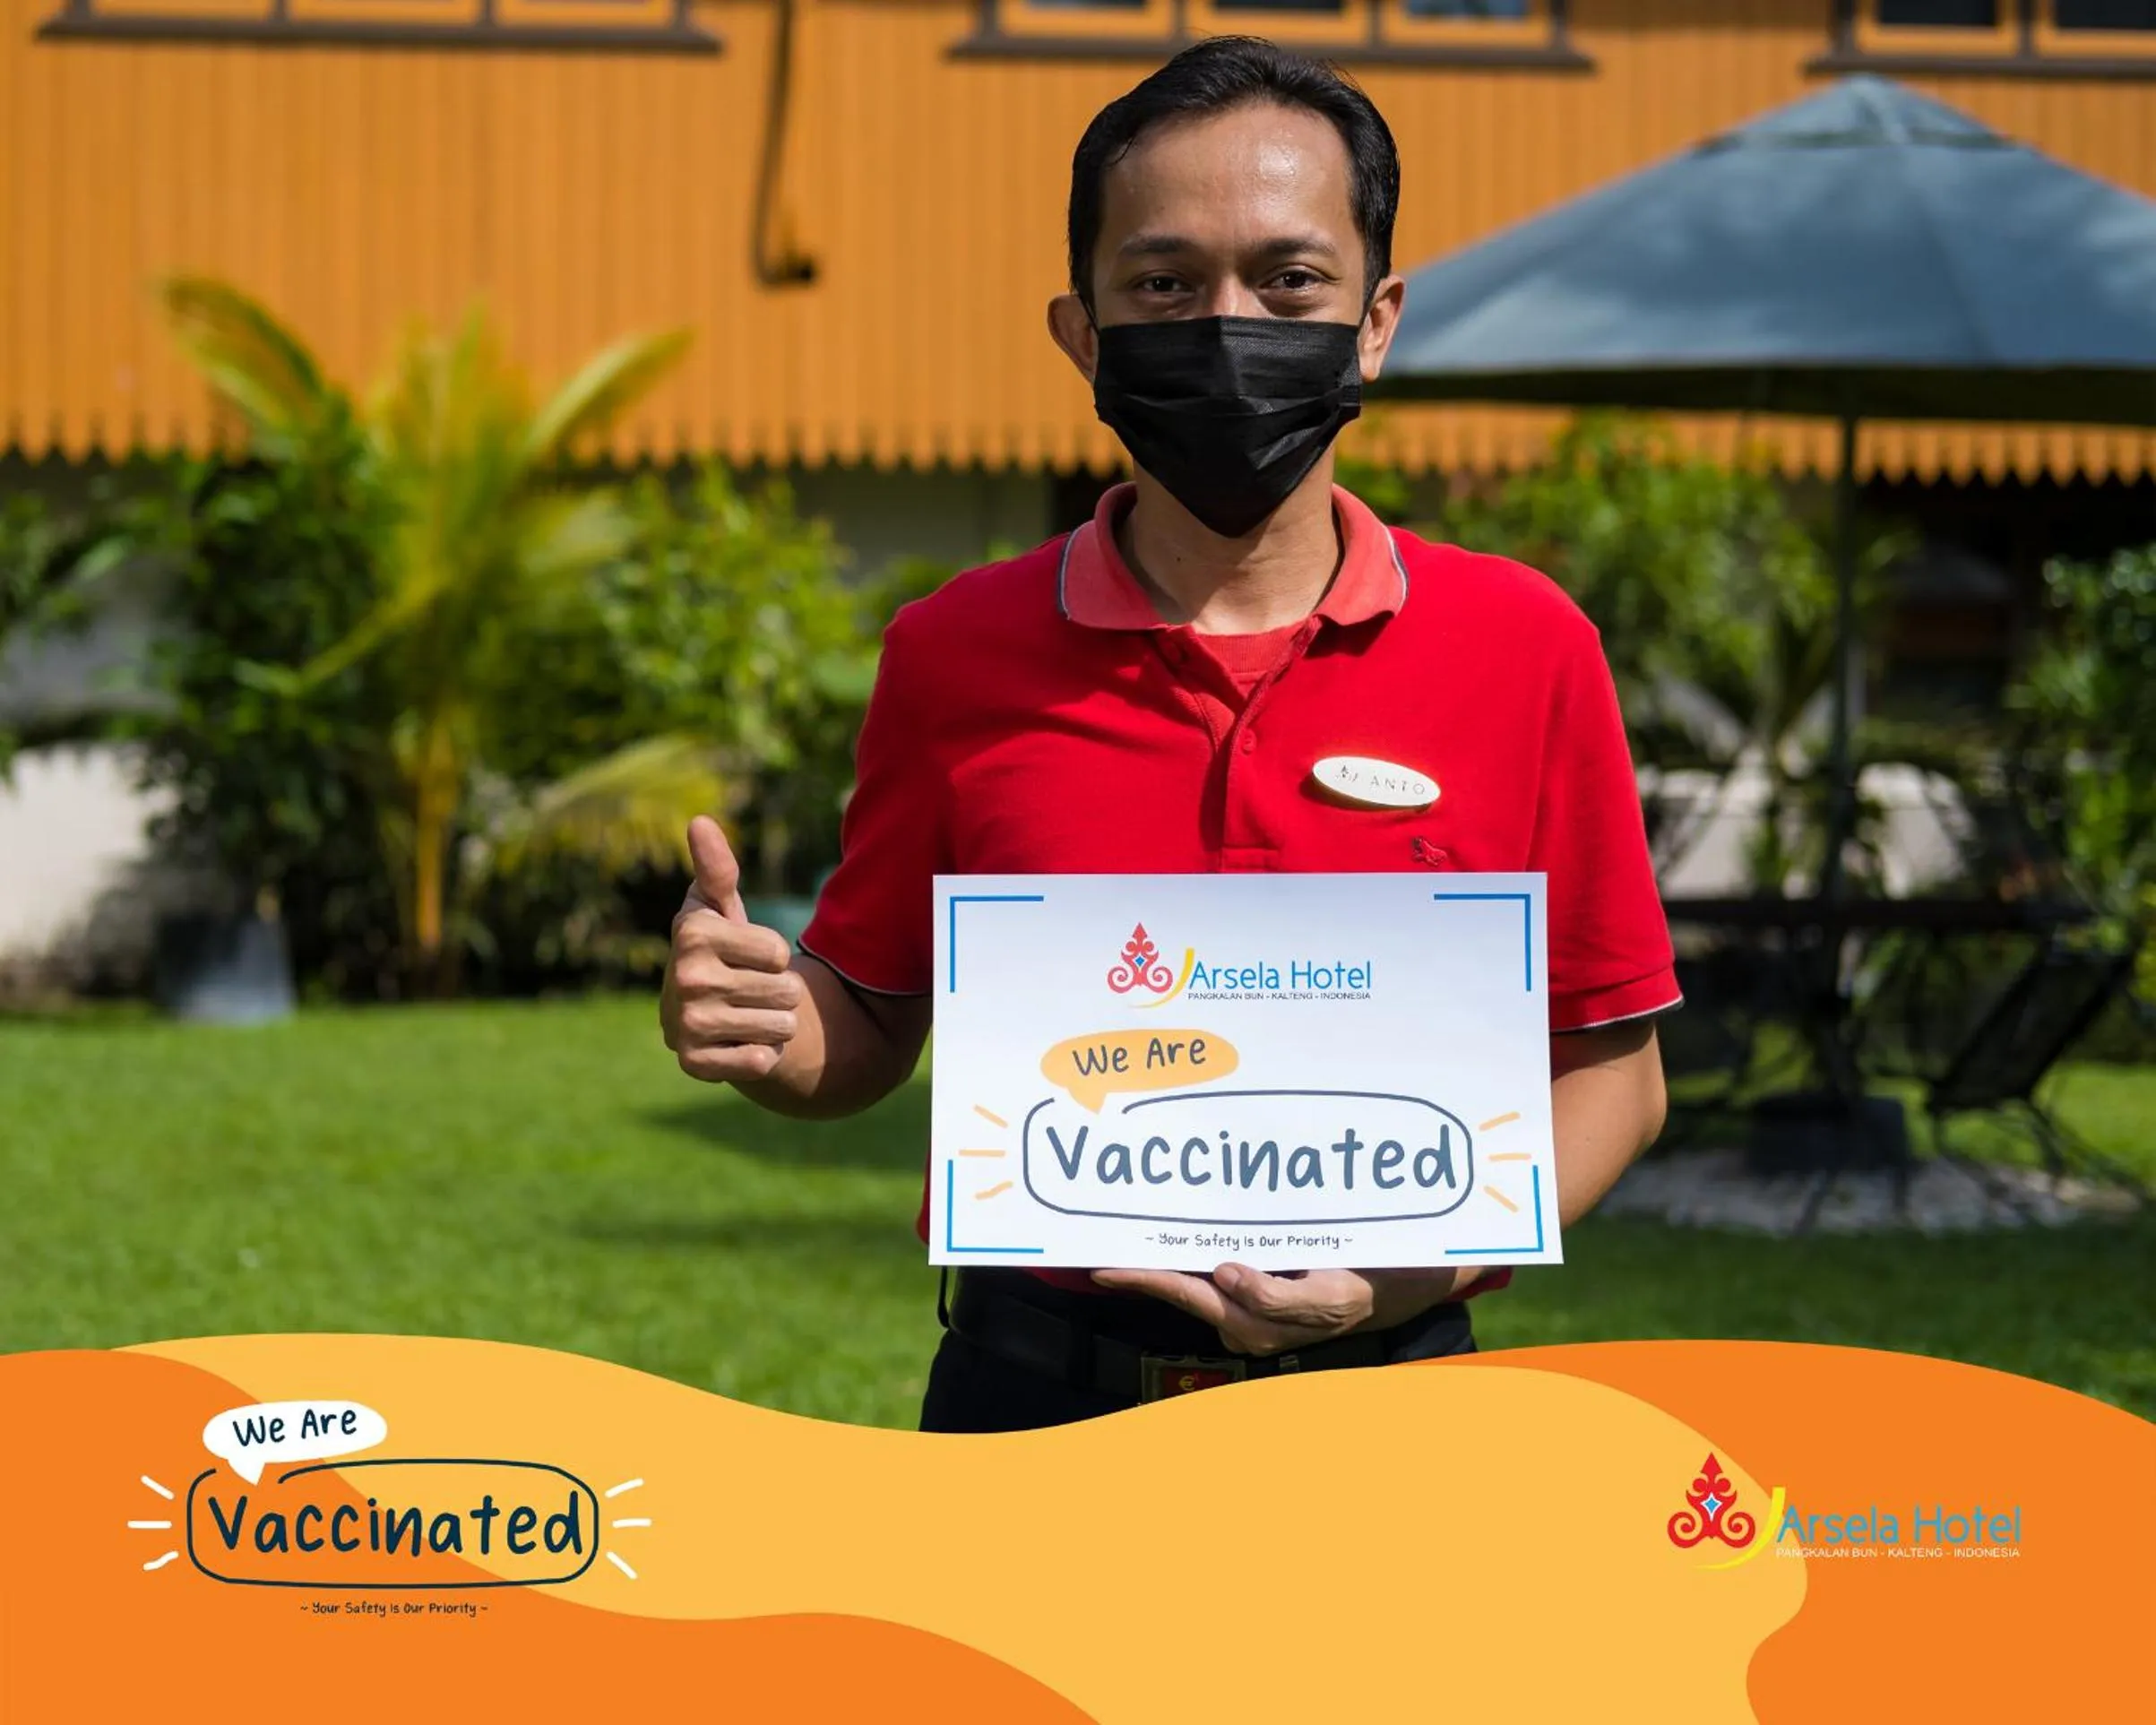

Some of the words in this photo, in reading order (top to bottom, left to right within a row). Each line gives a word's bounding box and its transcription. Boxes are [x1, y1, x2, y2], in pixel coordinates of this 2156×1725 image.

[1370, 774, 1426, 796] ANTO
[1188, 960, 1281, 990] Arsela
[1291, 960, 1371, 990] Hotel
[1187, 992, 1243, 1000] PANGKALAN
[1245, 992, 1264, 1000] BUN
[1272, 992, 1314, 1000] KALTENG
[1320, 992, 1372, 1000] INDONESIA
[1072, 1043, 1129, 1076] We
[1146, 1037, 1207, 1070] Are
[1045, 1124, 1458, 1193] Vaccinated
[1159, 1232, 1190, 1246] Your
[1194, 1233, 1240, 1252] Safety
[1259, 1236, 1282, 1246] Our
[1287, 1236, 1340, 1250] Priority
